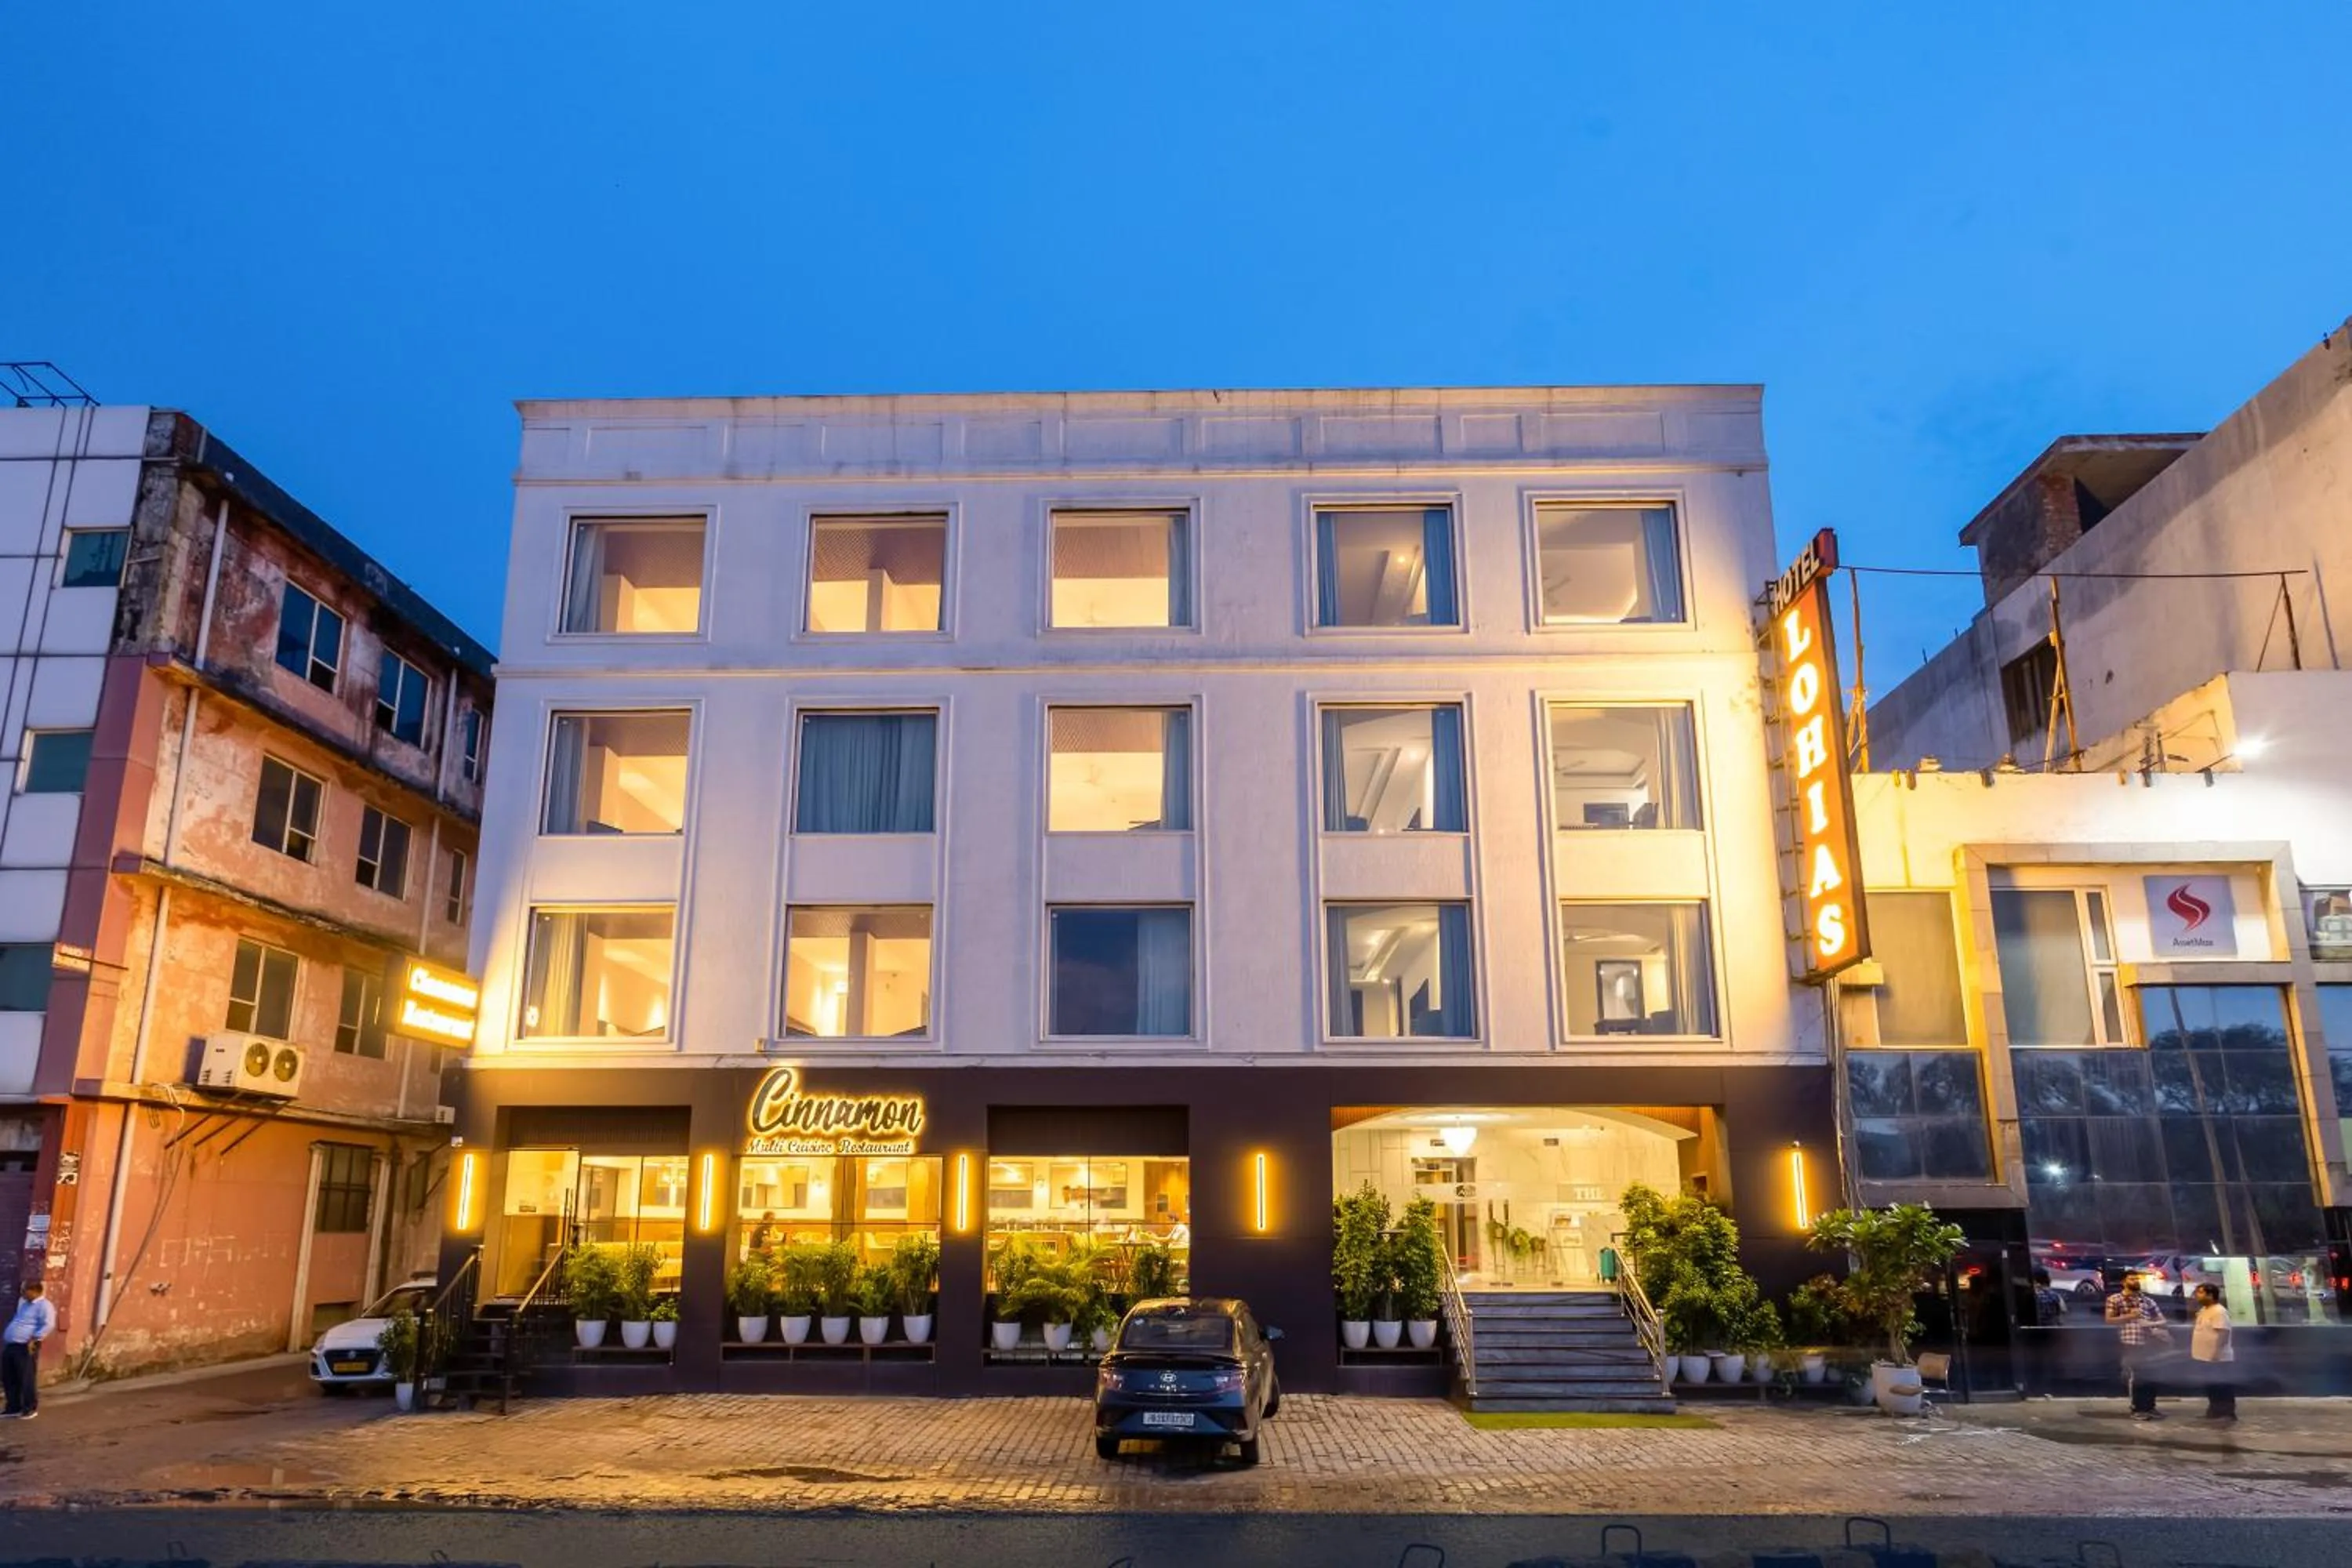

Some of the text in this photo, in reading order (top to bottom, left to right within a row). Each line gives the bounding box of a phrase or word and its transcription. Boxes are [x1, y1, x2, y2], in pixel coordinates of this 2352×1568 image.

[1774, 542, 1820, 618] HOTEL
[1784, 609, 1846, 957] LOHIAS
[752, 1068, 921, 1133] Cinnamon
[746, 1139, 910, 1153] Multi Cuisine Restaurant
